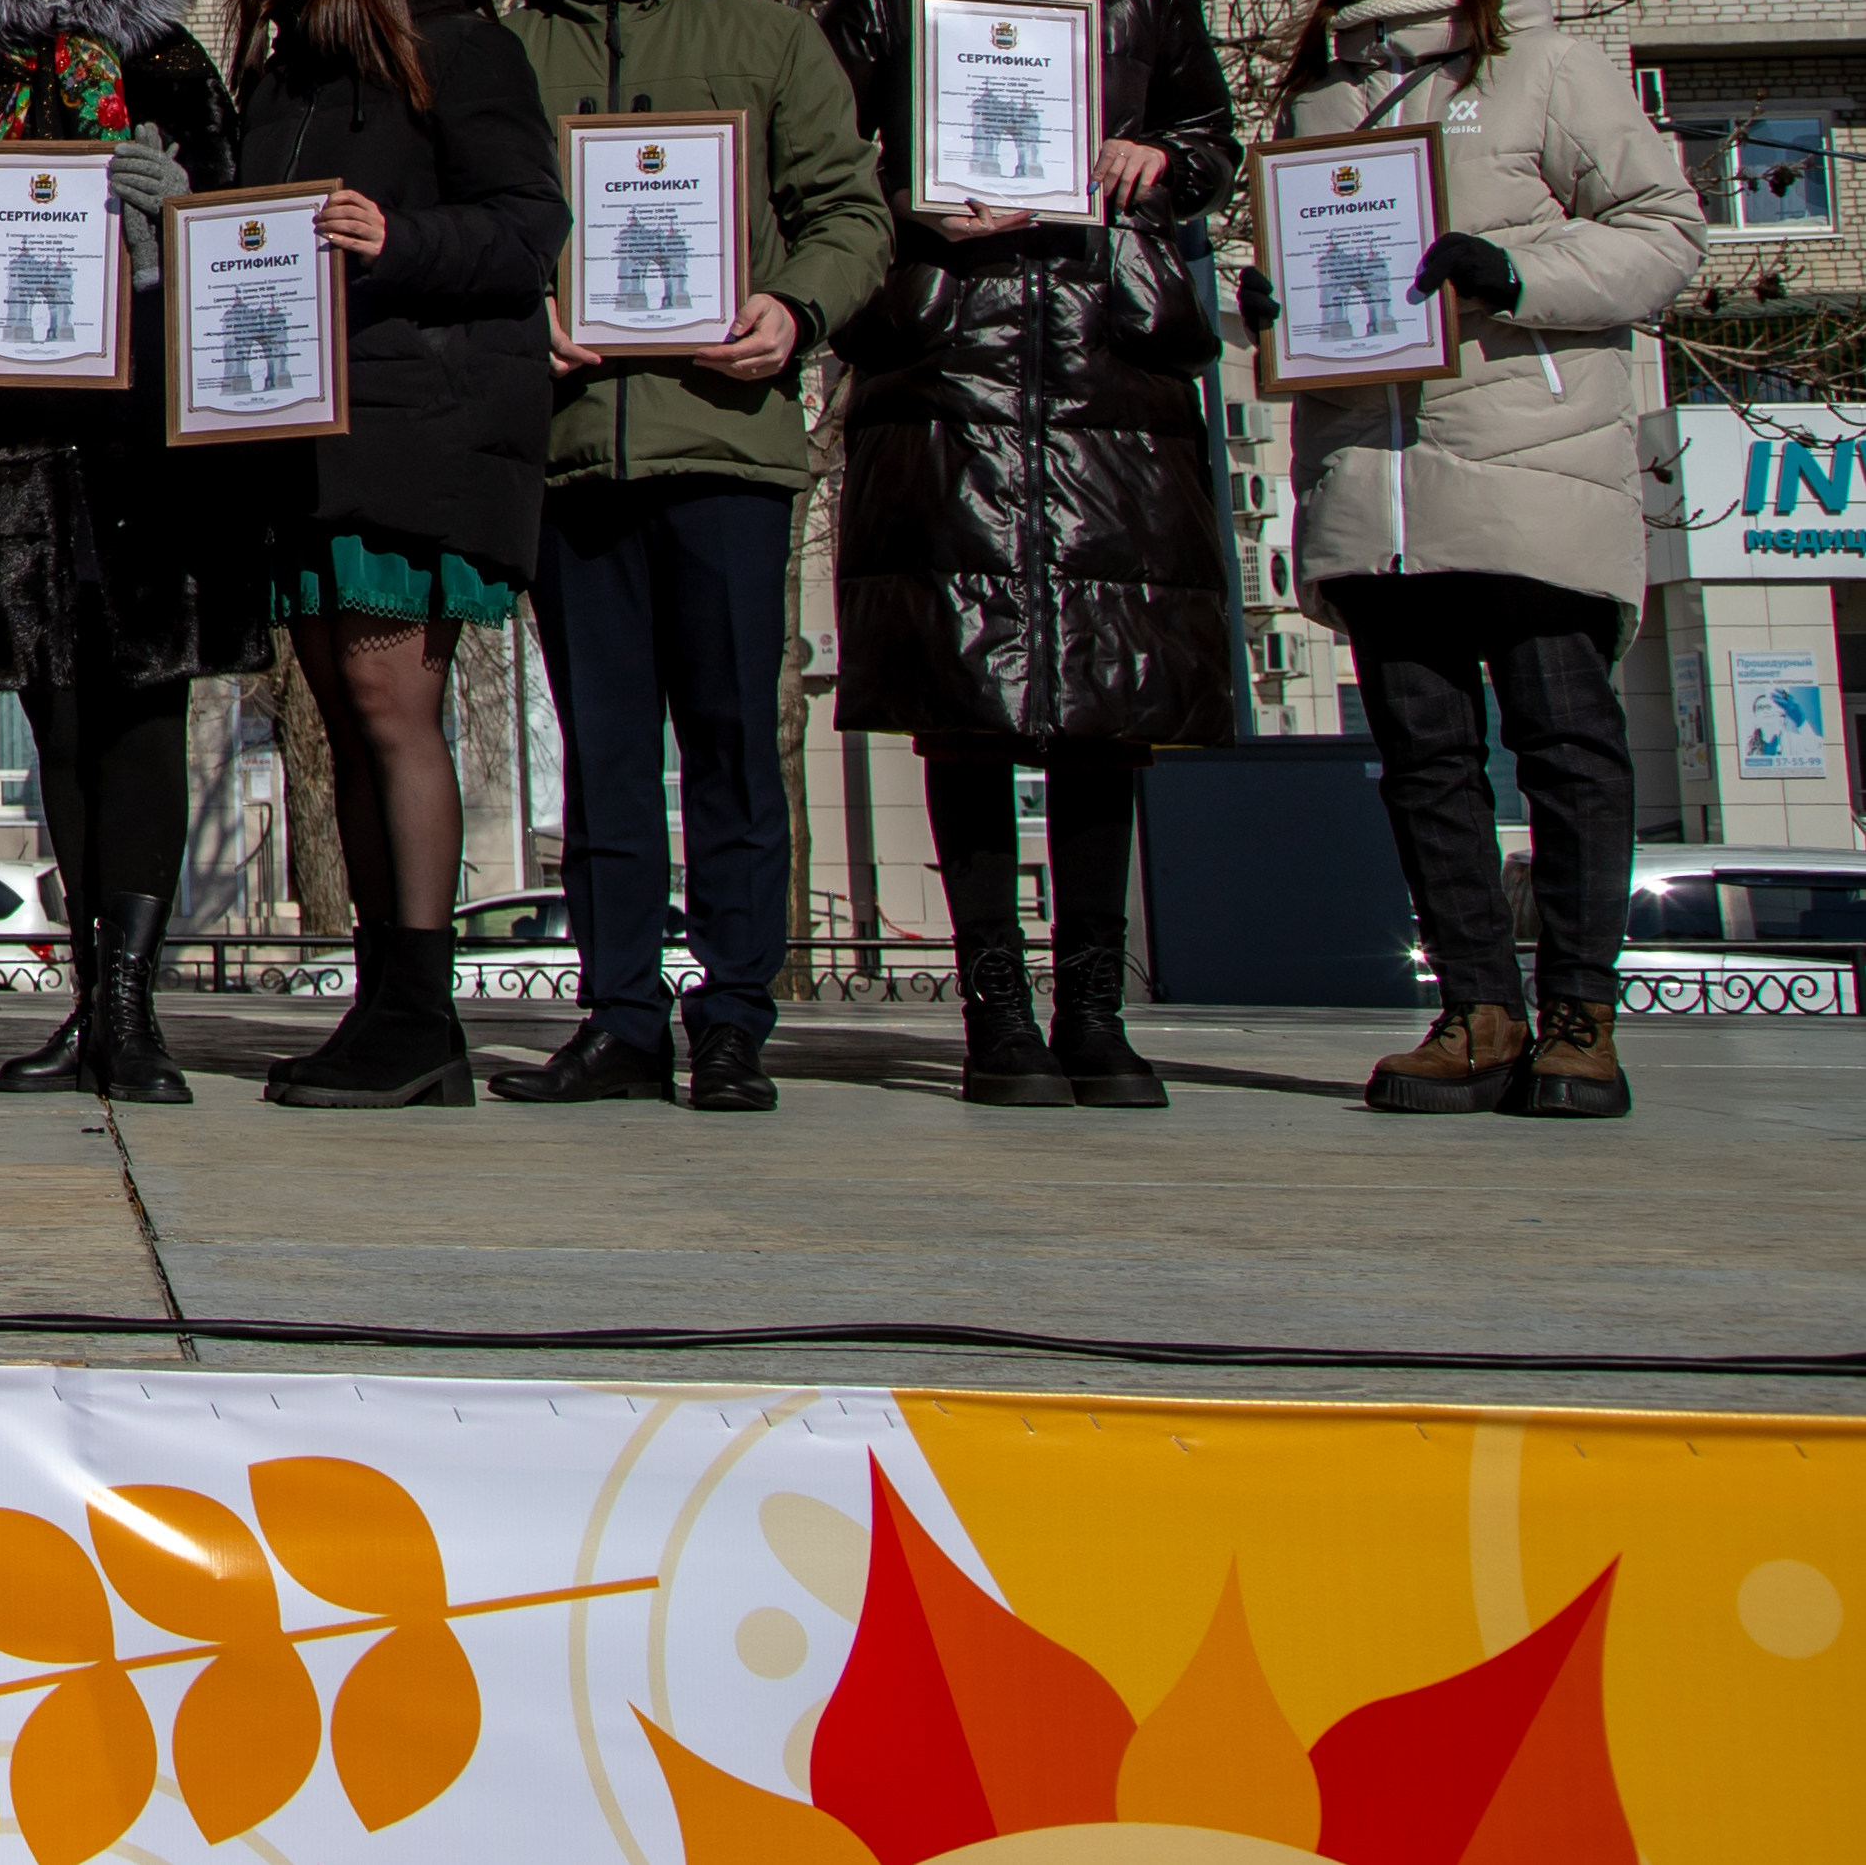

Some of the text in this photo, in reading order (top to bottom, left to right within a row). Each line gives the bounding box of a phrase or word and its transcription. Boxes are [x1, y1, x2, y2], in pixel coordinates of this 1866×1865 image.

[957, 53, 1052, 67] СЕРТИФИКАТ
[605, 179, 700, 192] СЕРТИФИКАТ
[1300, 198, 1397, 219] СЕРТИФИКАТ
[211, 254, 299, 273] СЕРТИФИКАТ
[1742, 439, 1866, 516] IN
[1737, 658, 1813, 669] Процедурный
[1738, 669, 1781, 678] кабинет
[1776, 757, 1822, 767] 57-55-99
